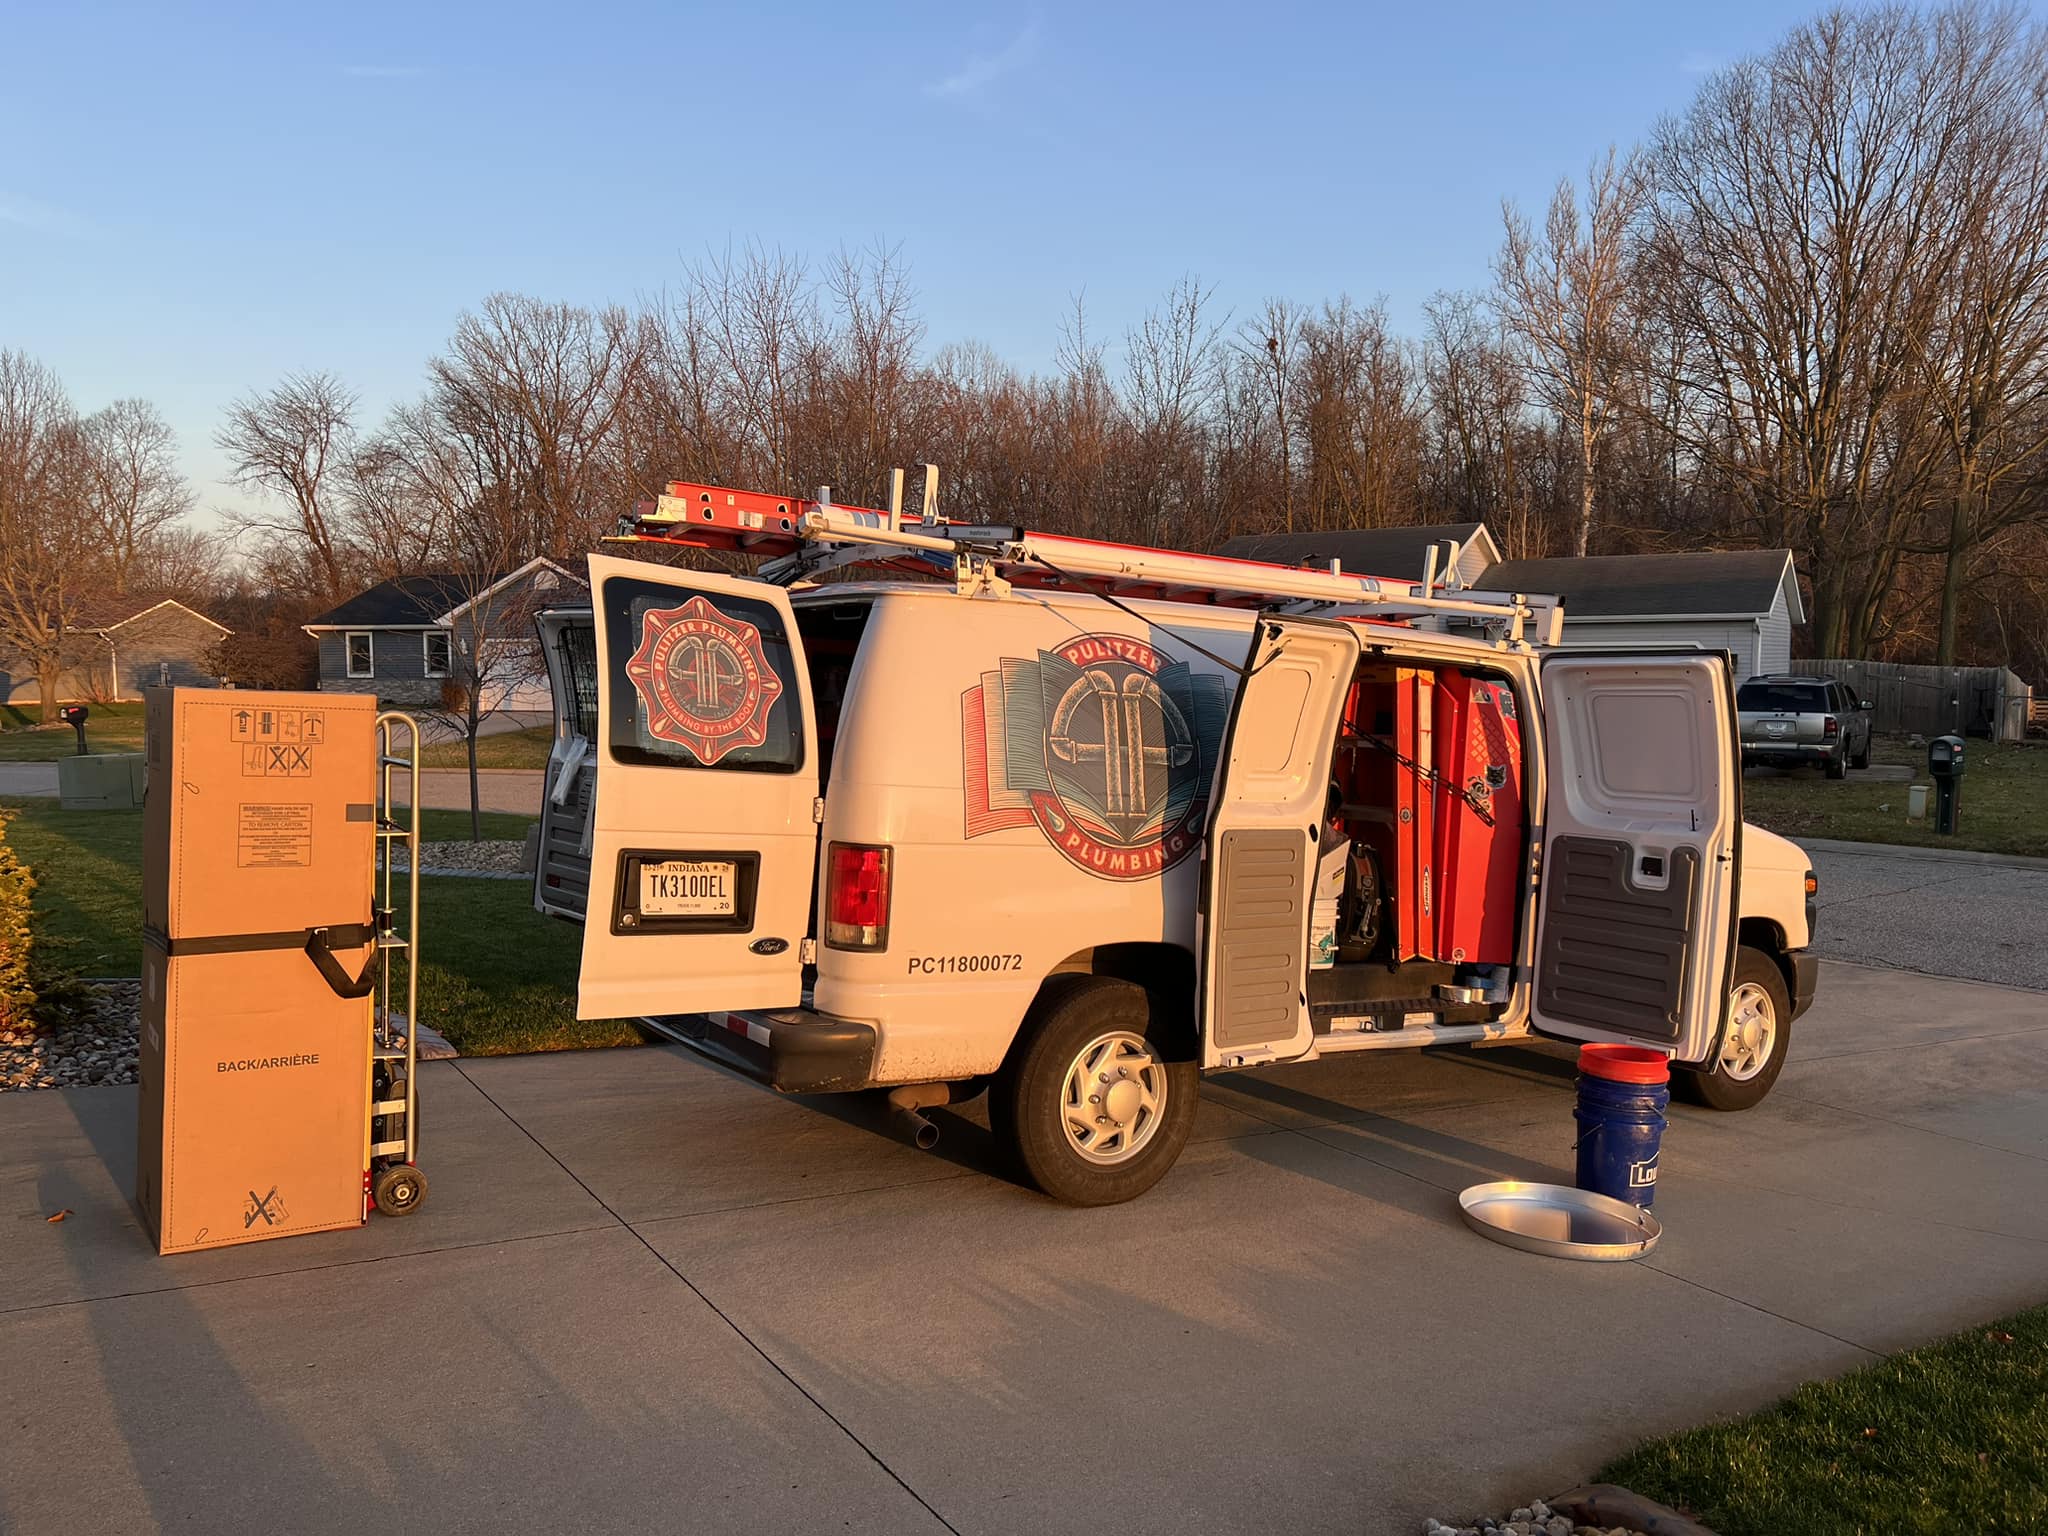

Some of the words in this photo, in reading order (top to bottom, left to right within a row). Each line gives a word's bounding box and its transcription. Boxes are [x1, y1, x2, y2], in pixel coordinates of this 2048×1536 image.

[654, 622, 696, 671] PULITZER
[702, 622, 757, 681] PLUMBING
[1066, 641, 1162, 673] PULITZER
[662, 692, 701, 731] PLUMBING
[717, 721, 735, 734] THE
[735, 702, 754, 727] BOOK
[1066, 833, 1184, 870] PLUMBING
[668, 864, 710, 872] INDIANA
[759, 941, 781, 951] Ford
[908, 954, 1023, 975] PC11800072
[217, 1053, 319, 1072] BACK/ARRIÈRE
